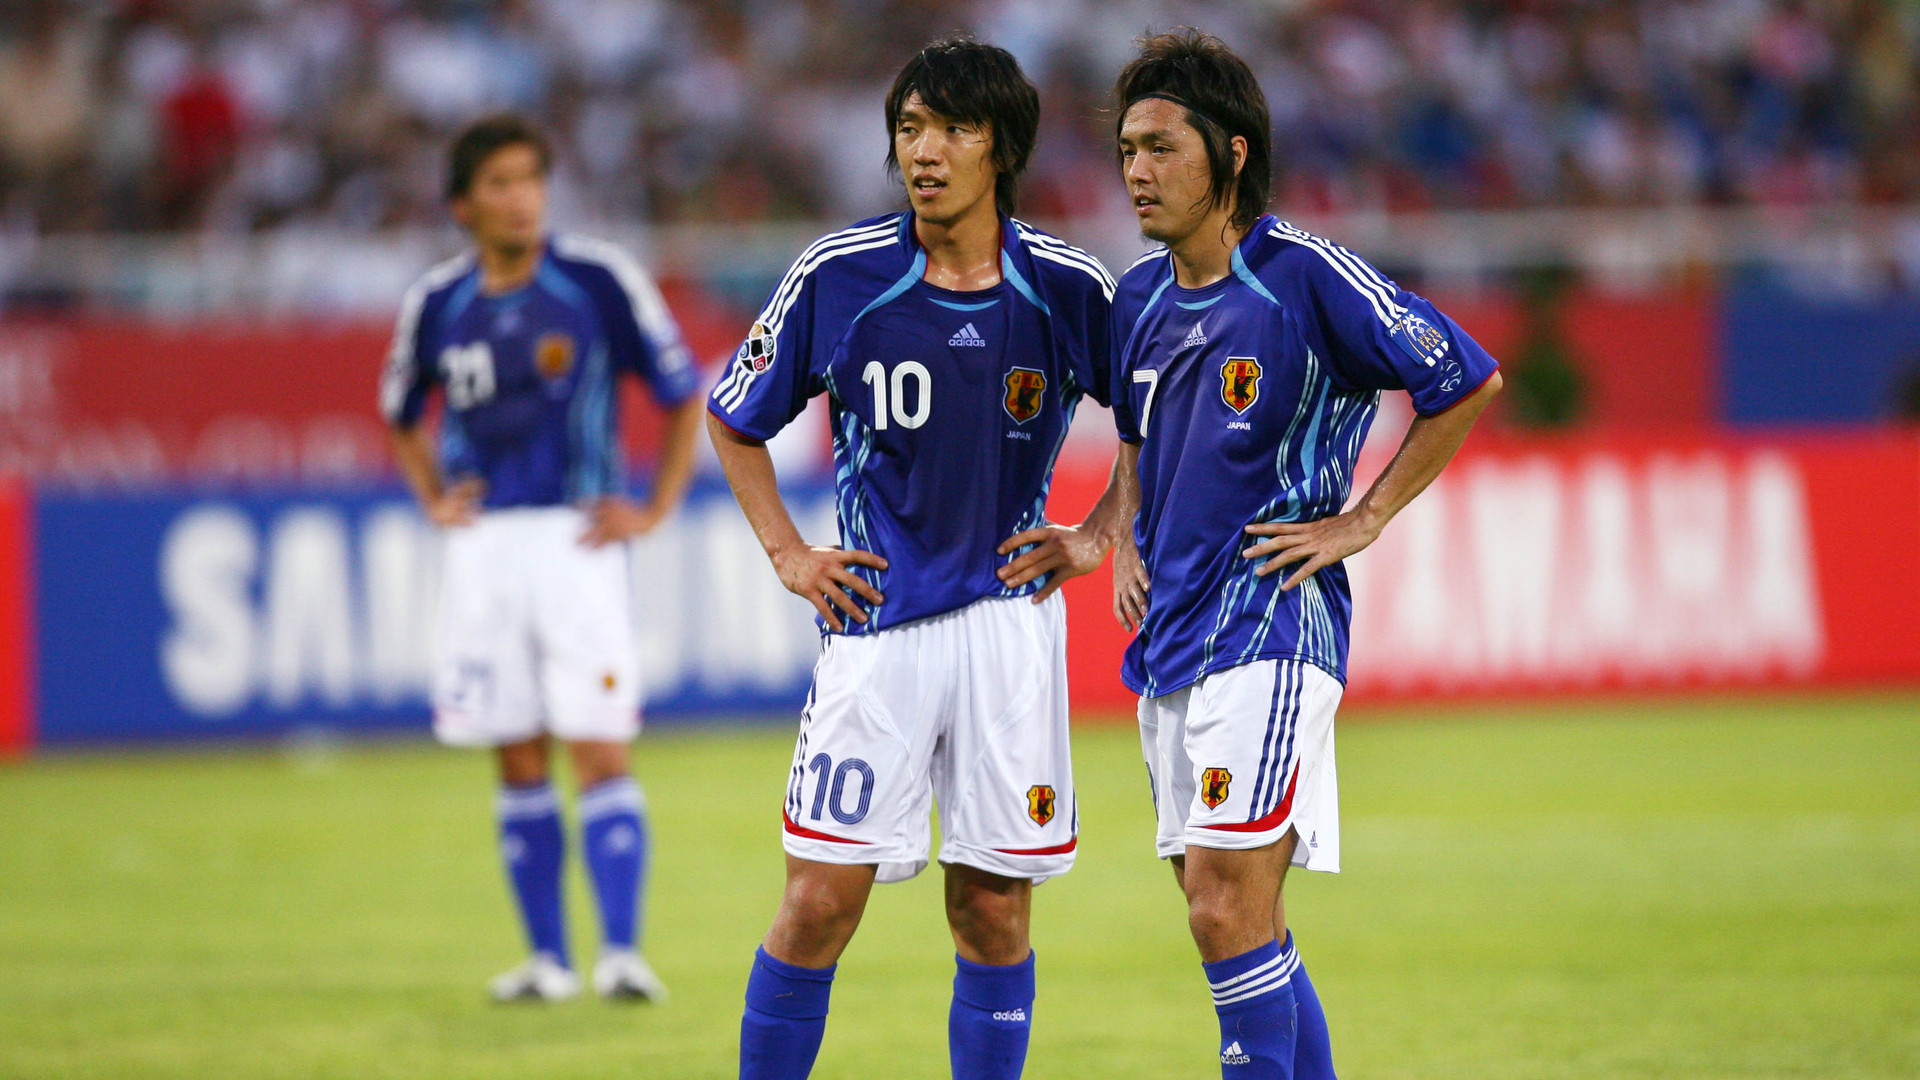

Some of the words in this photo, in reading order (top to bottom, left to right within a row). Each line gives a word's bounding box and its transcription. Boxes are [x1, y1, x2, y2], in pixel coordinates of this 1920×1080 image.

[948, 337, 986, 347] adidas
[1183, 337, 1208, 348] adidas
[1424, 333, 1444, 352] PLAY
[1228, 365, 1254, 375] JFA
[1013, 375, 1040, 387] JFA
[861, 360, 932, 431] 10
[1132, 369, 1158, 439] 7
[1226, 421, 1251, 431] JAPAN
[1006, 430, 1032, 441] JAPAN
[1205, 772, 1226, 781] JFA
[808, 752, 875, 825] 10
[993, 1009, 1026, 1021] adidas
